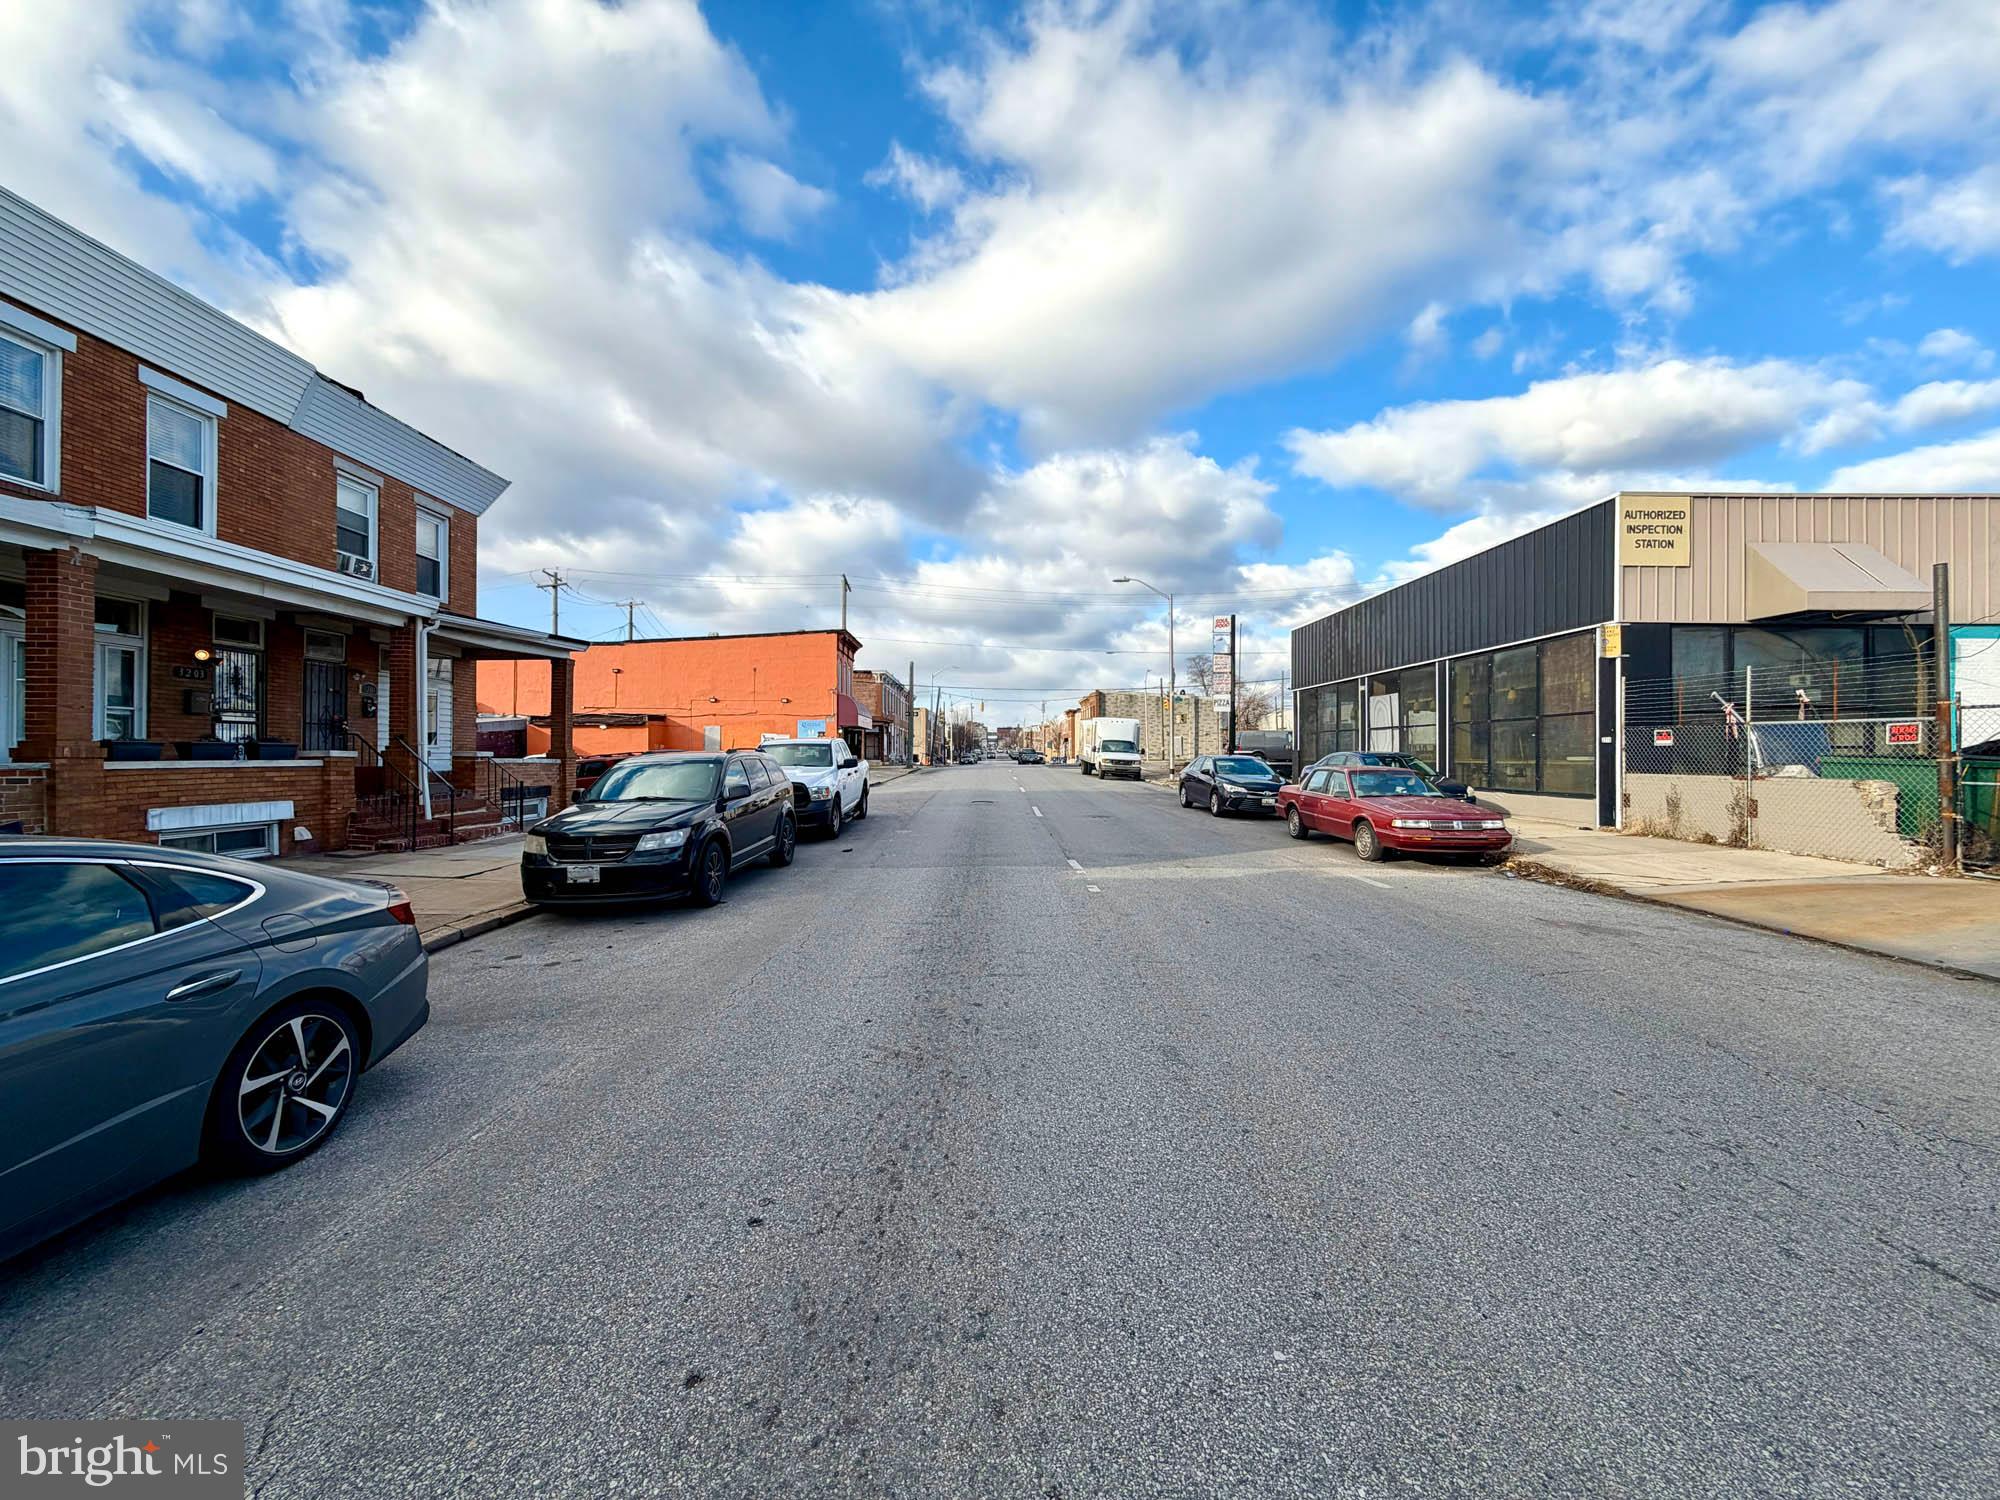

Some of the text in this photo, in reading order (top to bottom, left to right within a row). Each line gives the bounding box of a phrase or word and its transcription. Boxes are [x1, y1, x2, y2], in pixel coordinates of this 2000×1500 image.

[1624, 510, 1686, 520] AUTHORIZED
[1626, 524, 1683, 534] INSPECTION
[1634, 539, 1674, 549] STATION
[1213, 699, 1230, 707] PIZZA
